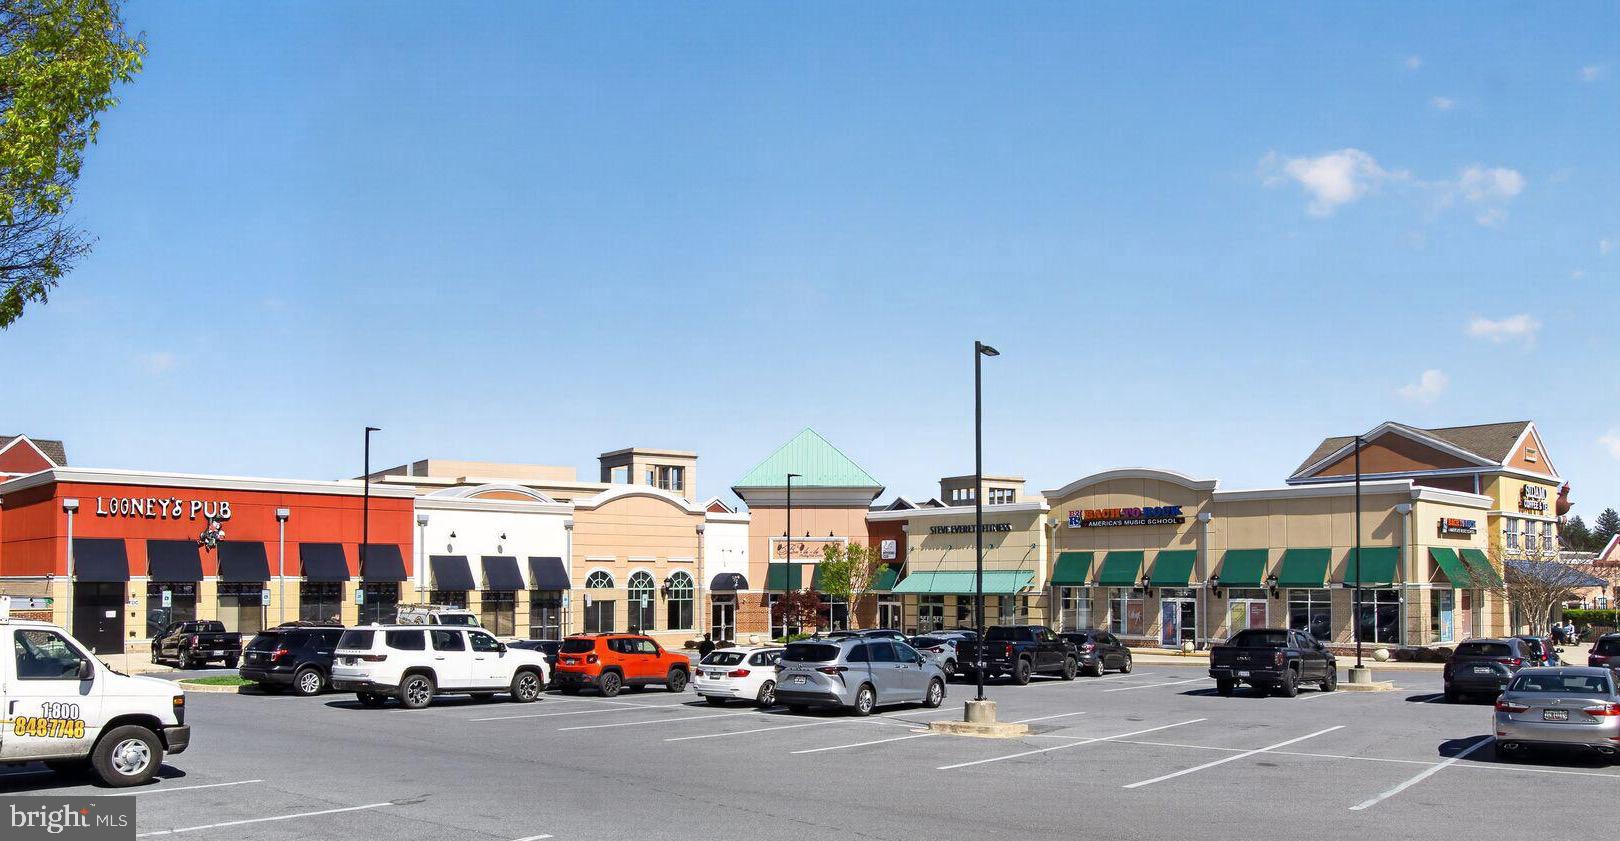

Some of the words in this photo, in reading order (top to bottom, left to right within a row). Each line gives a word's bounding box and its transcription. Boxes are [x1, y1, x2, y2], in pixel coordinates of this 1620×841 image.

[96, 496, 182, 519] LOONEY'S
[189, 500, 231, 520] PUB
[929, 525, 951, 534] STEVE
[1124, 518, 1146, 526] MUSIC
[1147, 517, 1177, 525] SCHOOL
[42, 702, 80, 720] 1-800
[14, 716, 86, 738] 848-7748
